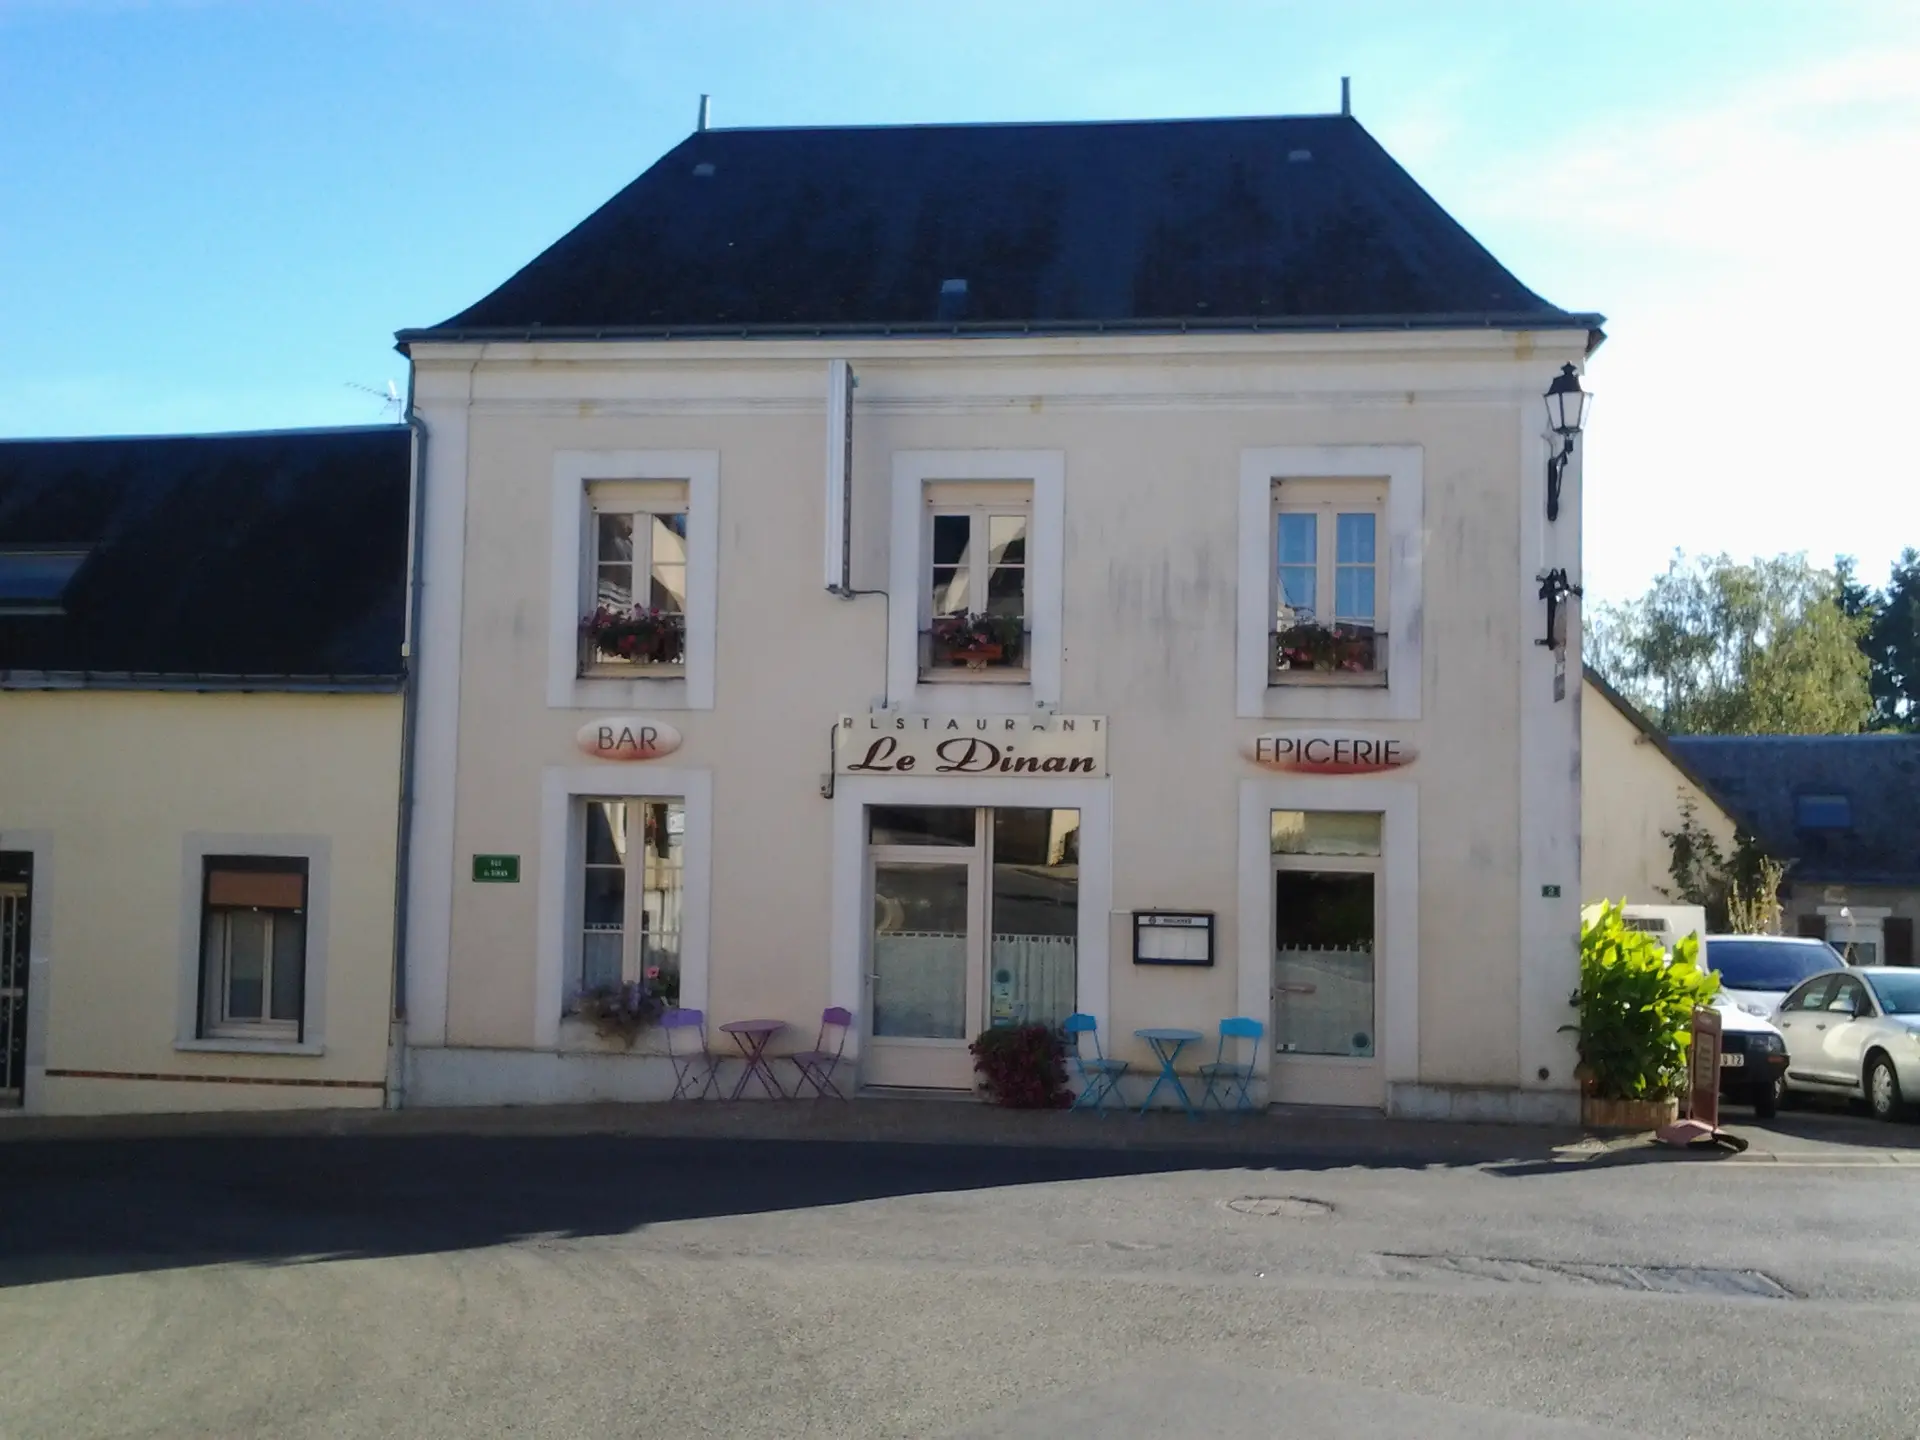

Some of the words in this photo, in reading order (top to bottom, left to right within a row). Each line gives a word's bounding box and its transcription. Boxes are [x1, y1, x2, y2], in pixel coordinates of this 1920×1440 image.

[597, 726, 658, 750] BAR
[1255, 737, 1401, 767] EPICERIE
[847, 736, 916, 772] Le
[935, 737, 1097, 773] Dinan
